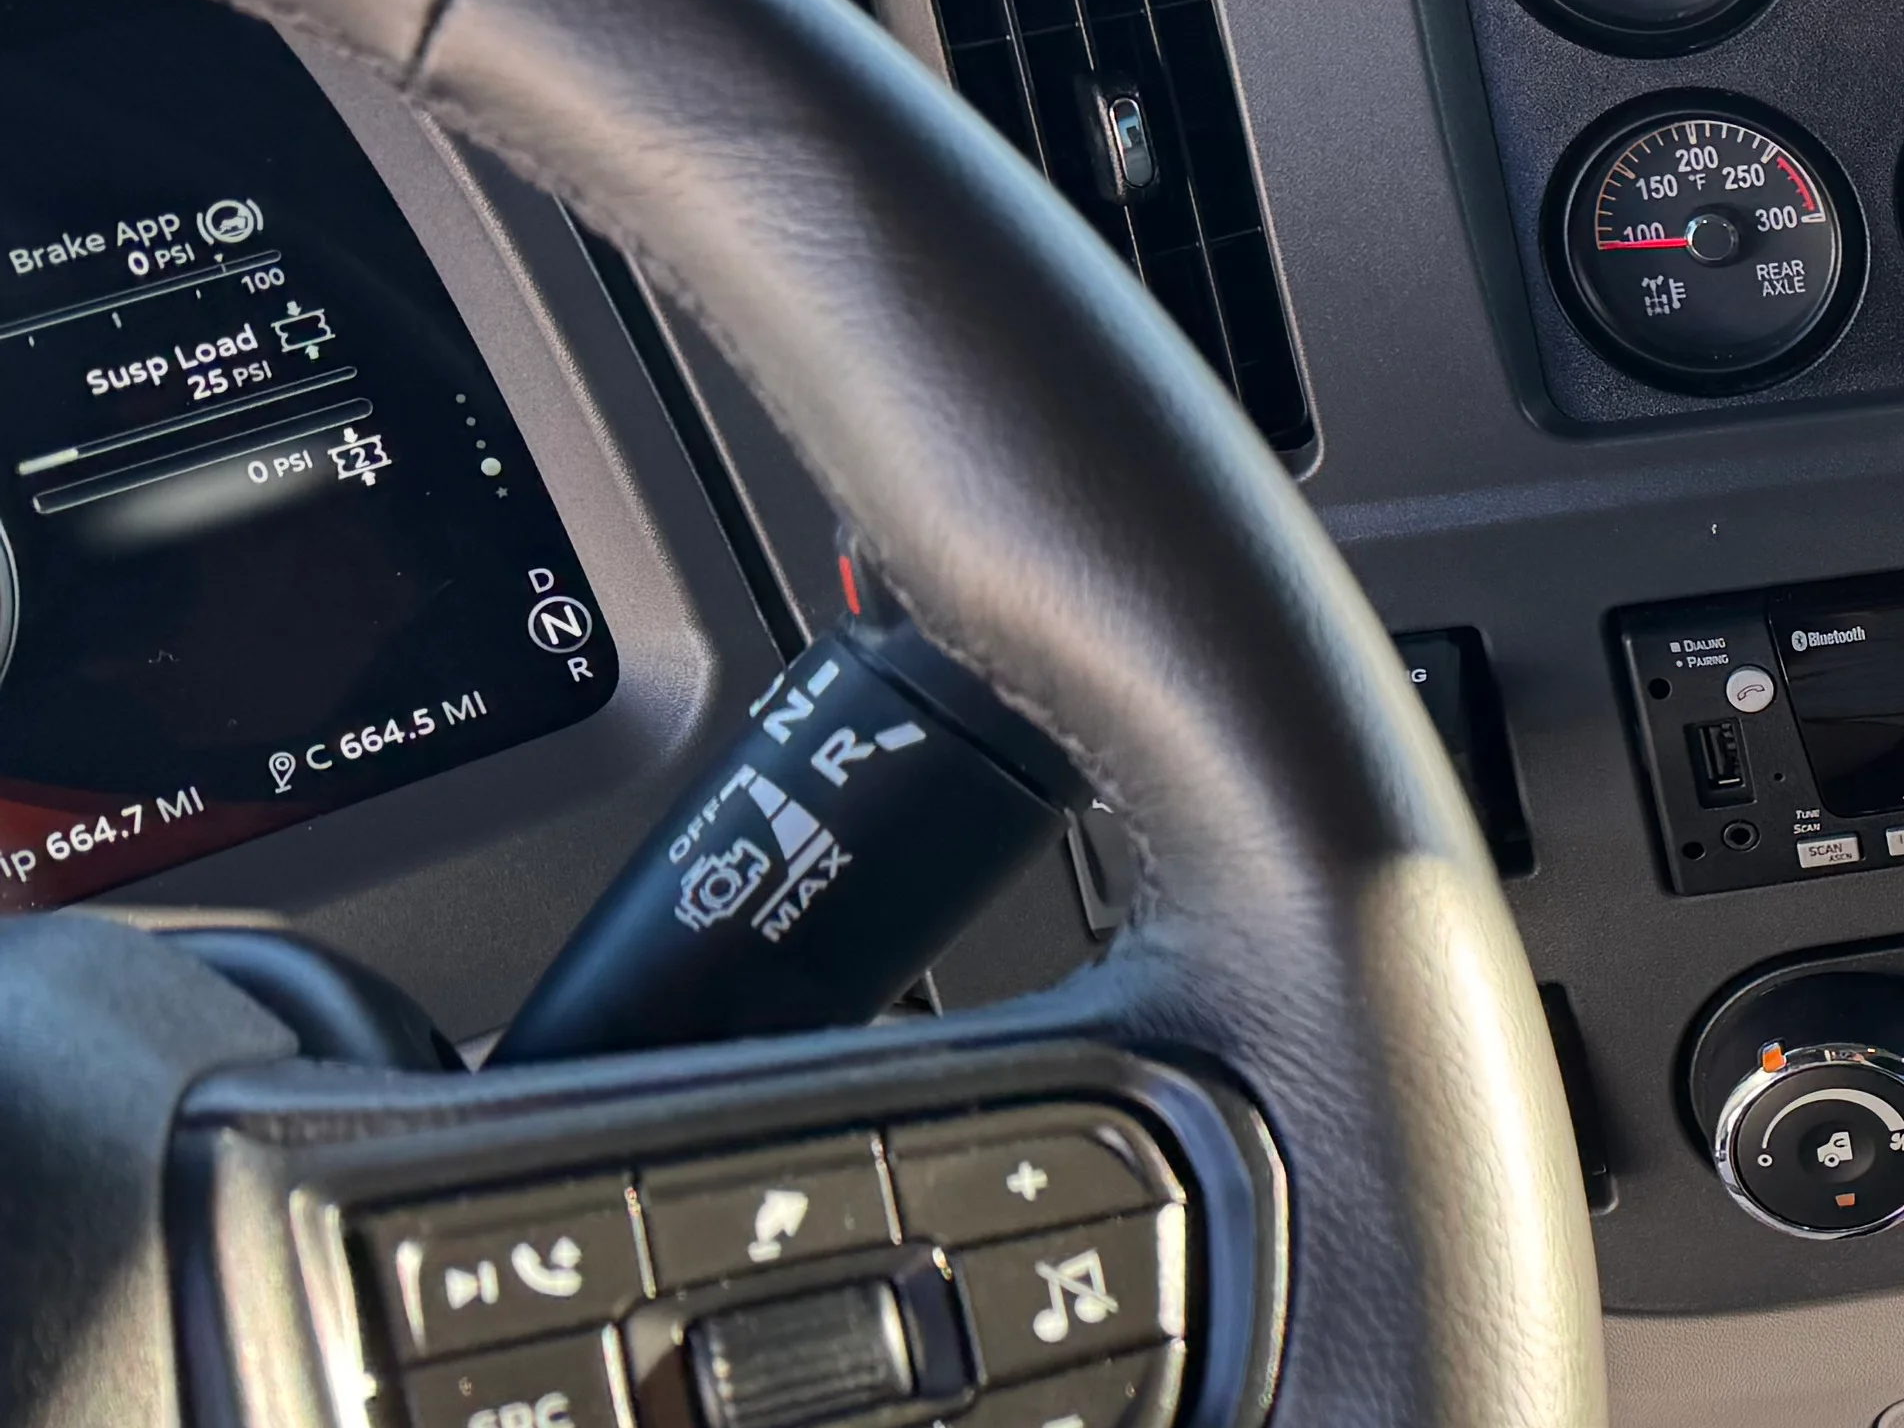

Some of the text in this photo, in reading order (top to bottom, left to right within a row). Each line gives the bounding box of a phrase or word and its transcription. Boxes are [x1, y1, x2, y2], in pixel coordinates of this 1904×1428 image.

[1675, 145, 1719, 172] 200
[1635, 174, 1678, 201] 150
[1722, 163, 1765, 190] 250
[1755, 205, 1797, 232] 300
[9, 213, 181, 274] Brake App
[127, 243, 195, 276] 0 PSI
[1756, 259, 1805, 280] REAR
[241, 267, 285, 295] 100
[1762, 276, 1805, 297] AXLE
[86, 323, 259, 396] Susp Load
[187, 360, 273, 400] 25 PSI
[248, 450, 313, 483] 0 PSI
[528, 568, 556, 594] D
[541, 605, 583, 647] N
[1807, 626, 1866, 648] Bluetooth
[568, 657, 594, 682] R
[306, 691, 487, 770] C 664.5 MI
[763, 695, 814, 745] N
[812, 728, 876, 787] R
[46, 804, 142, 860] 664.7
[156, 786, 204, 823] MI
[667, 796, 721, 864] OFF
[1794, 823, 1820, 834] SCAN
[1809, 842, 1842, 857] SCAN
[761, 845, 853, 942] MAX
